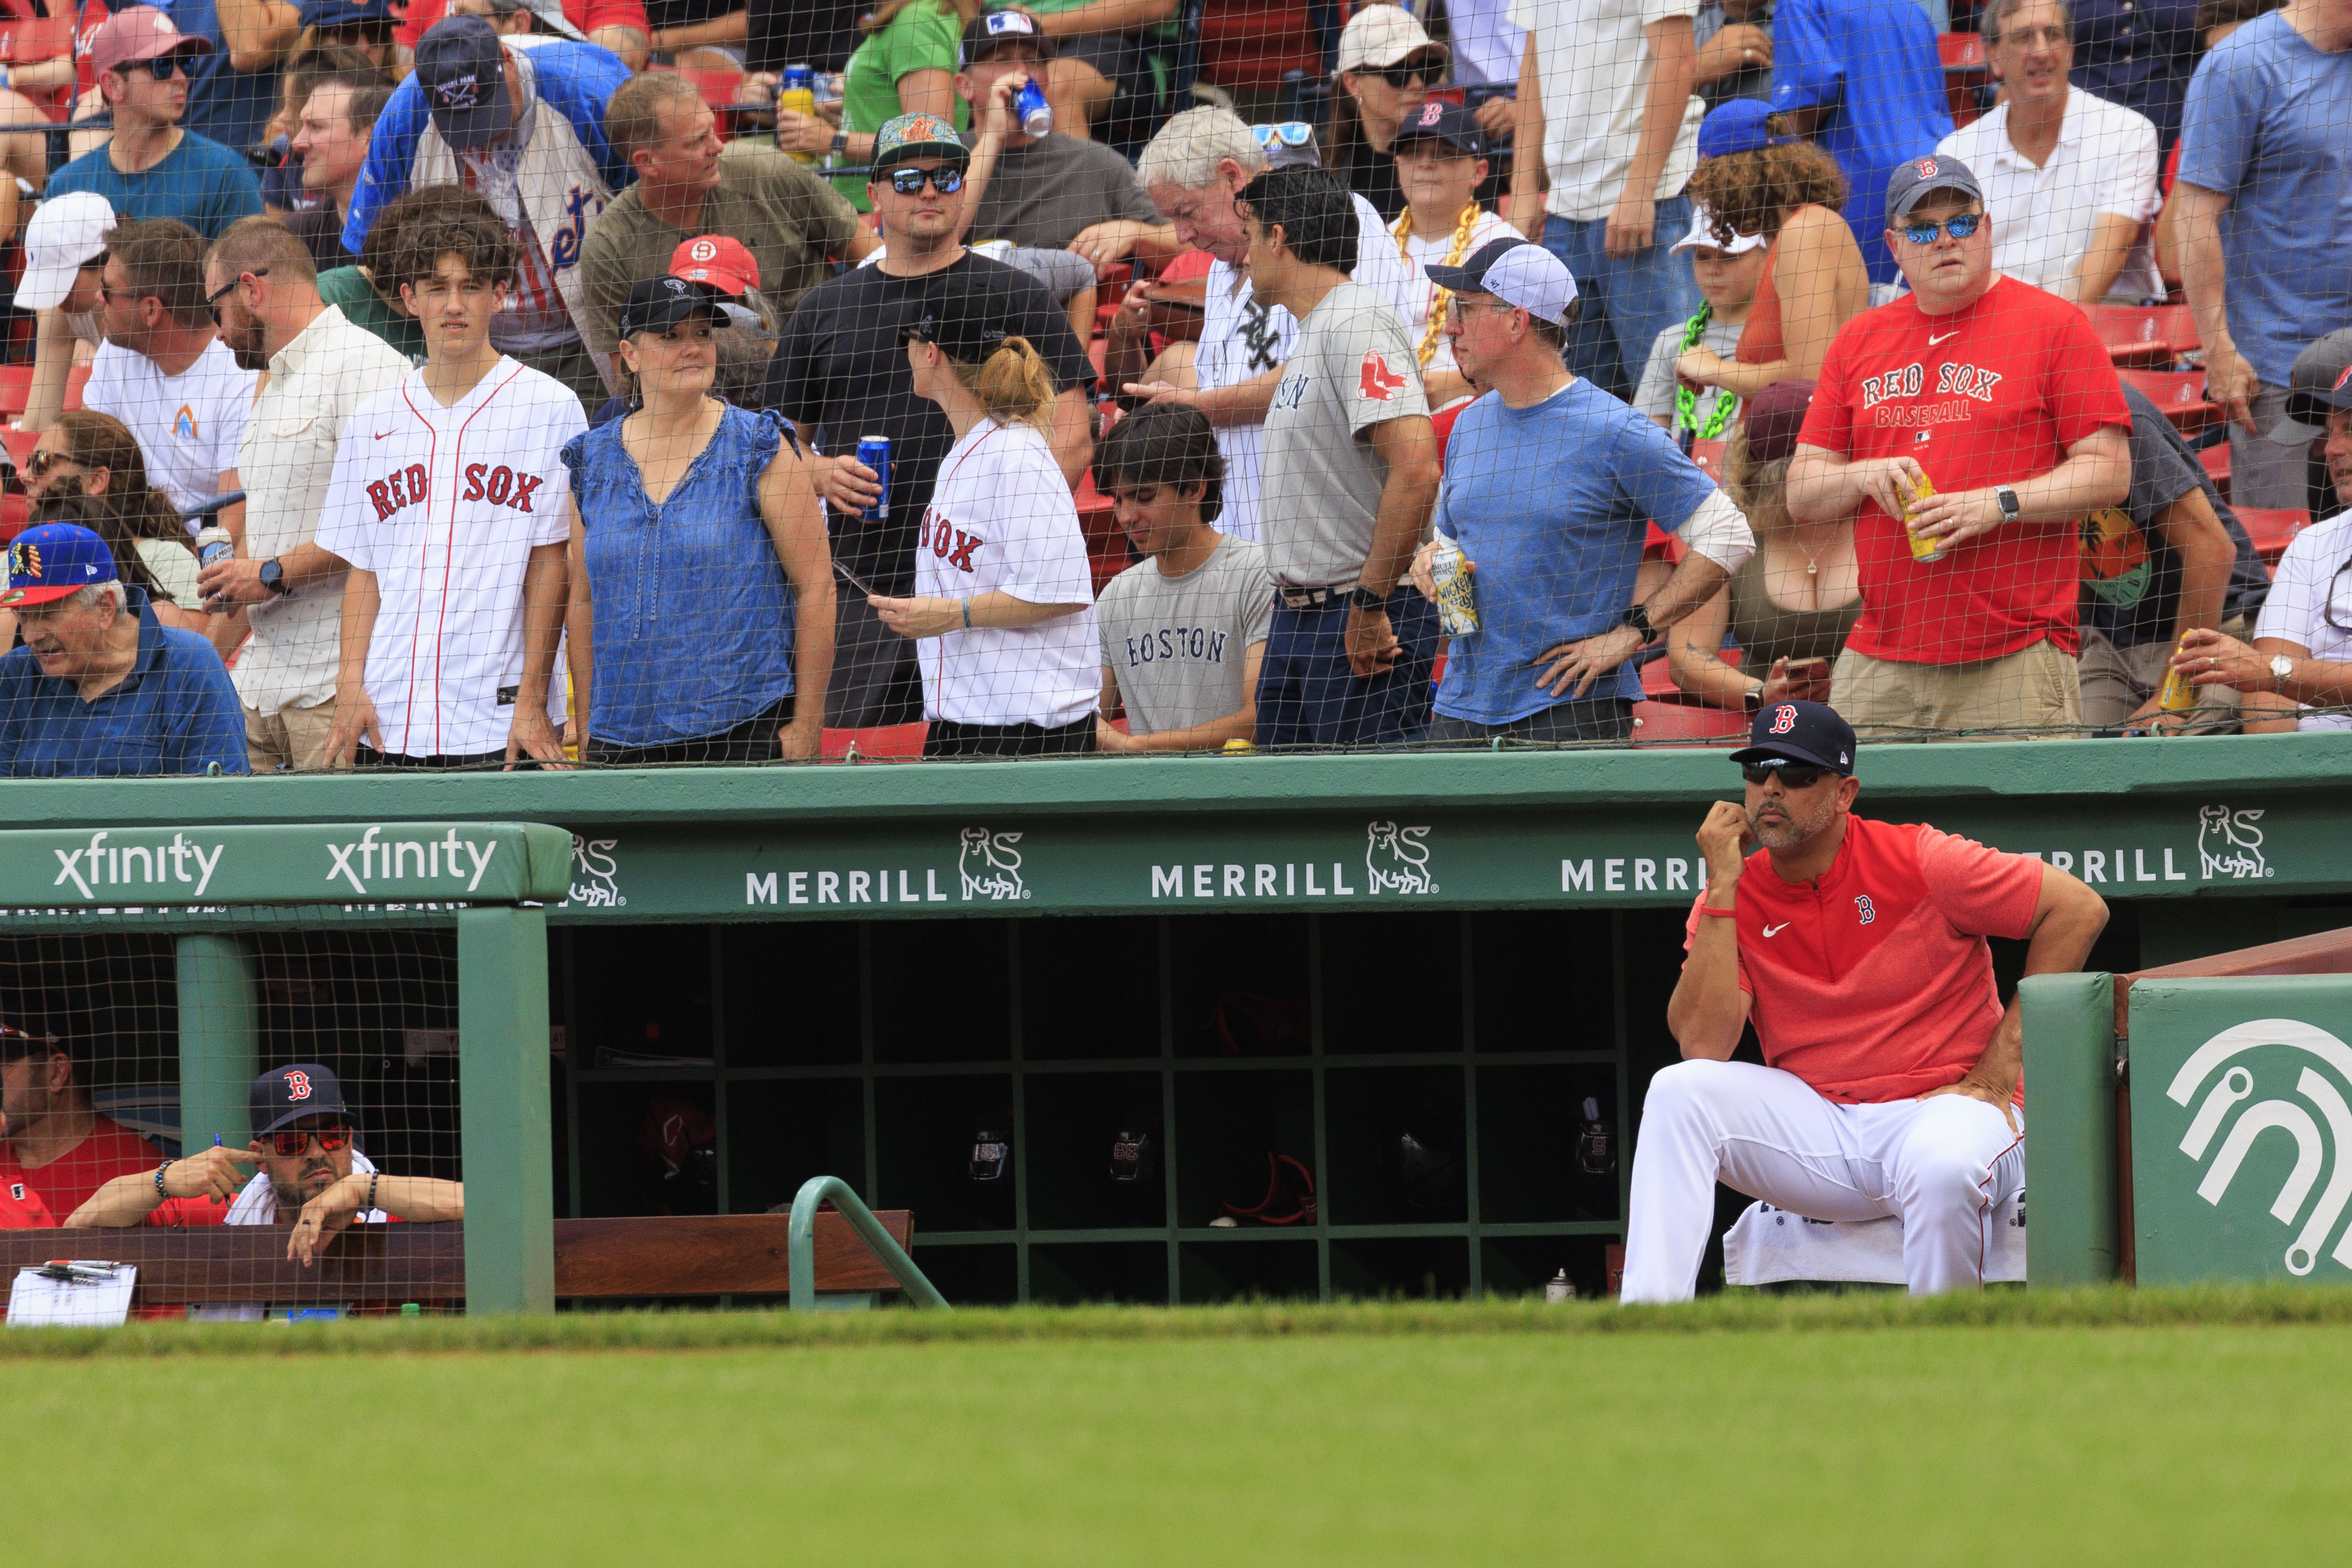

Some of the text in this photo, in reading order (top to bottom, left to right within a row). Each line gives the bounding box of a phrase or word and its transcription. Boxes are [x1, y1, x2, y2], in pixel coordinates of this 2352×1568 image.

[1418, 101, 1444, 127] B
[1916, 158, 1940, 181] B
[1862, 362, 2002, 410] RED SOX
[1875, 399, 1971, 428] BASEBALL
[366, 463, 543, 522] RED SOX
[1127, 627, 1228, 668] BOSTON
[1769, 704, 1799, 734] B
[53, 832, 225, 899] xfinity
[325, 826, 497, 894] xfinity
[1561, 857, 1707, 892] MERRI
[2022, 847, 2186, 884] RRILL
[746, 869, 947, 905] MERRILL
[1151, 861, 1354, 898] MERRILL
[1853, 894, 1876, 925] B
[283, 1069, 313, 1101] B
